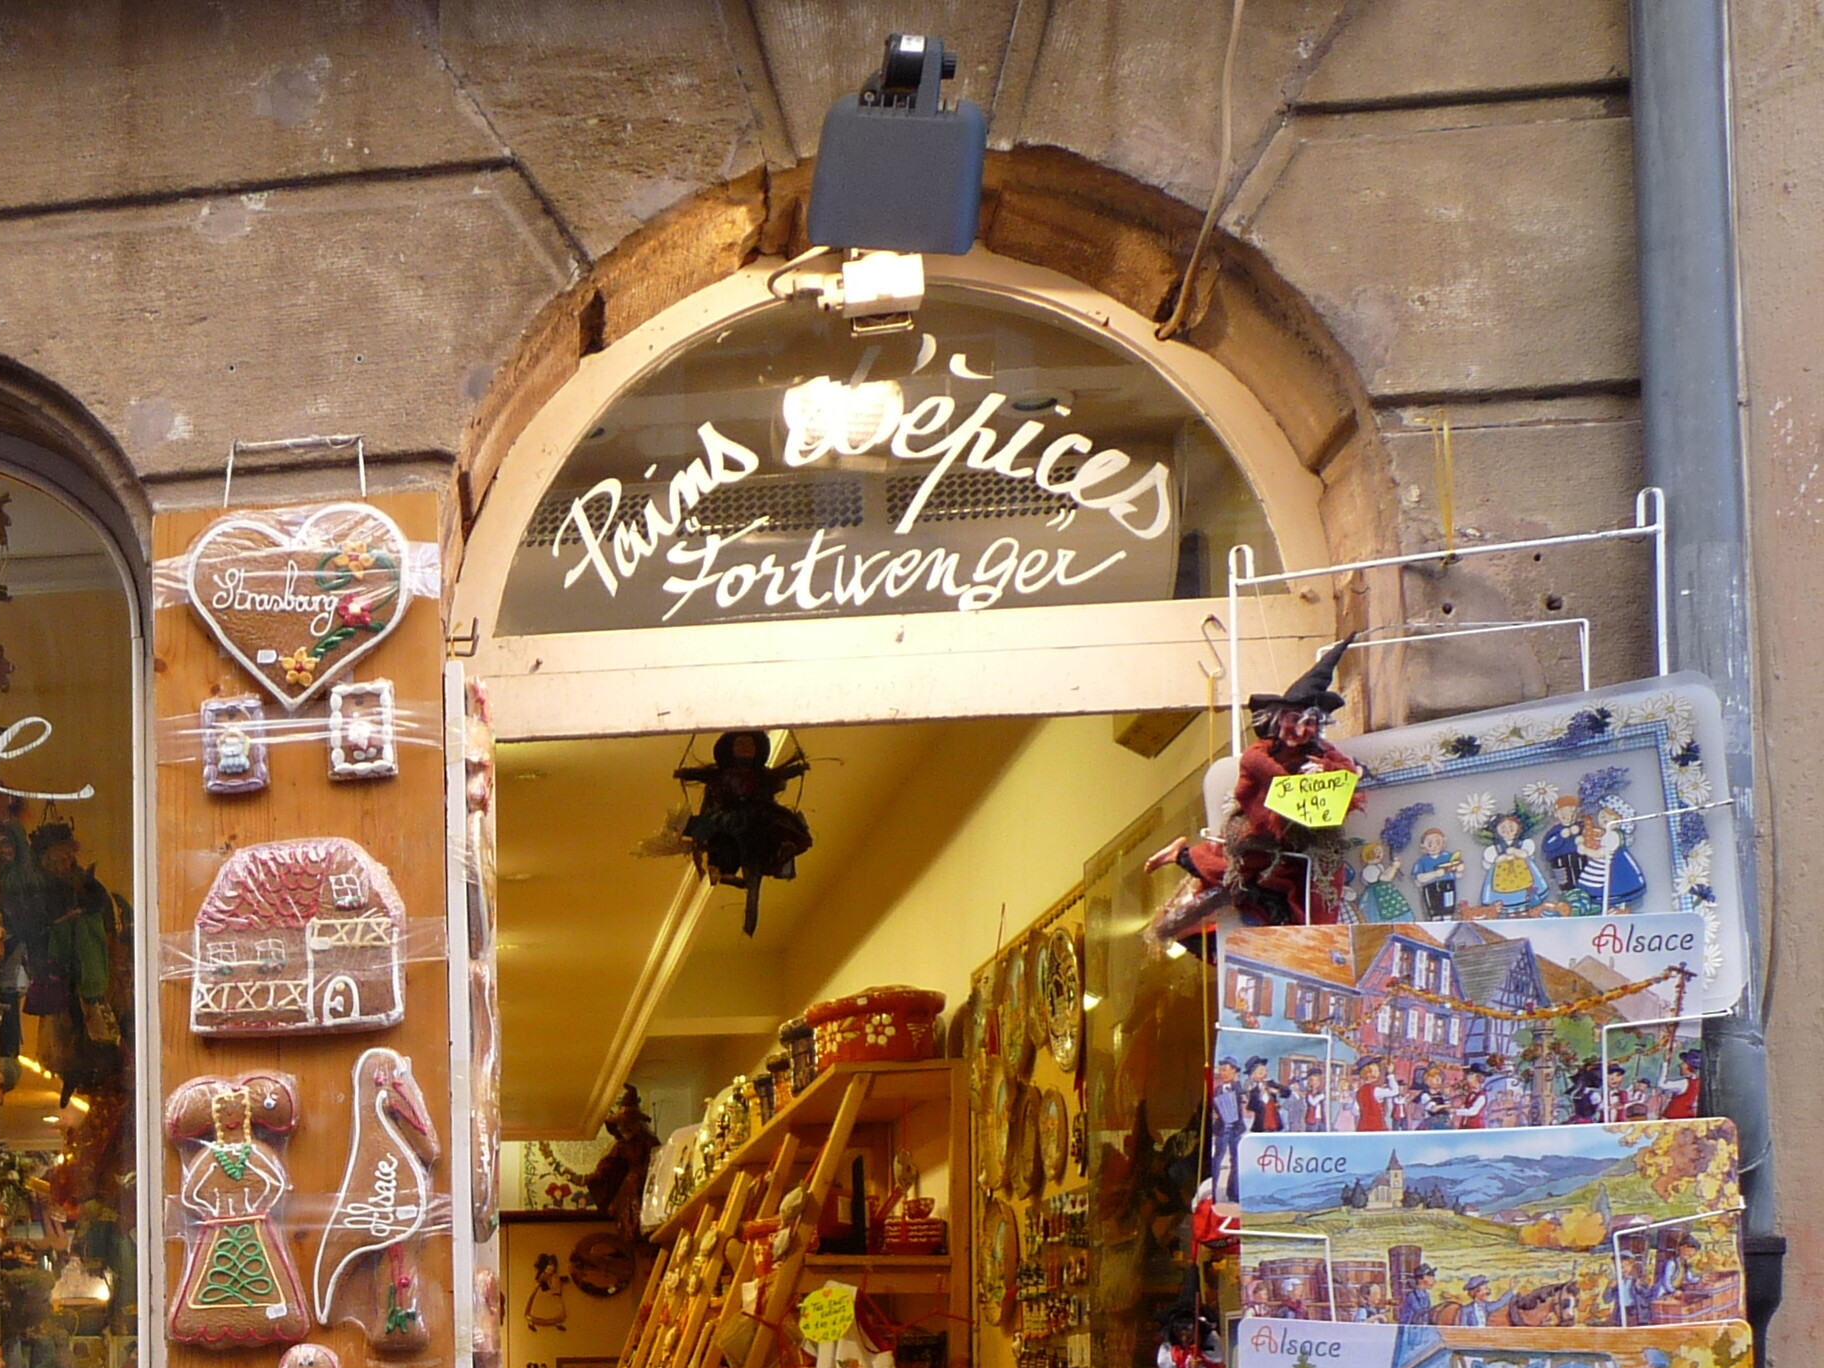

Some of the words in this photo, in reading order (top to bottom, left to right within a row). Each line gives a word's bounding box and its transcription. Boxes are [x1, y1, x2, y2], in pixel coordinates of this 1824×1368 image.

[553, 422, 759, 597] Pains
[213, 560, 340, 637] Strasbourg
[1591, 923, 1694, 955] Alsace
[1256, 1144, 1347, 1175] Alsace
[344, 1153, 398, 1237] Alsace
[1250, 1325, 1342, 1359] Alsace
